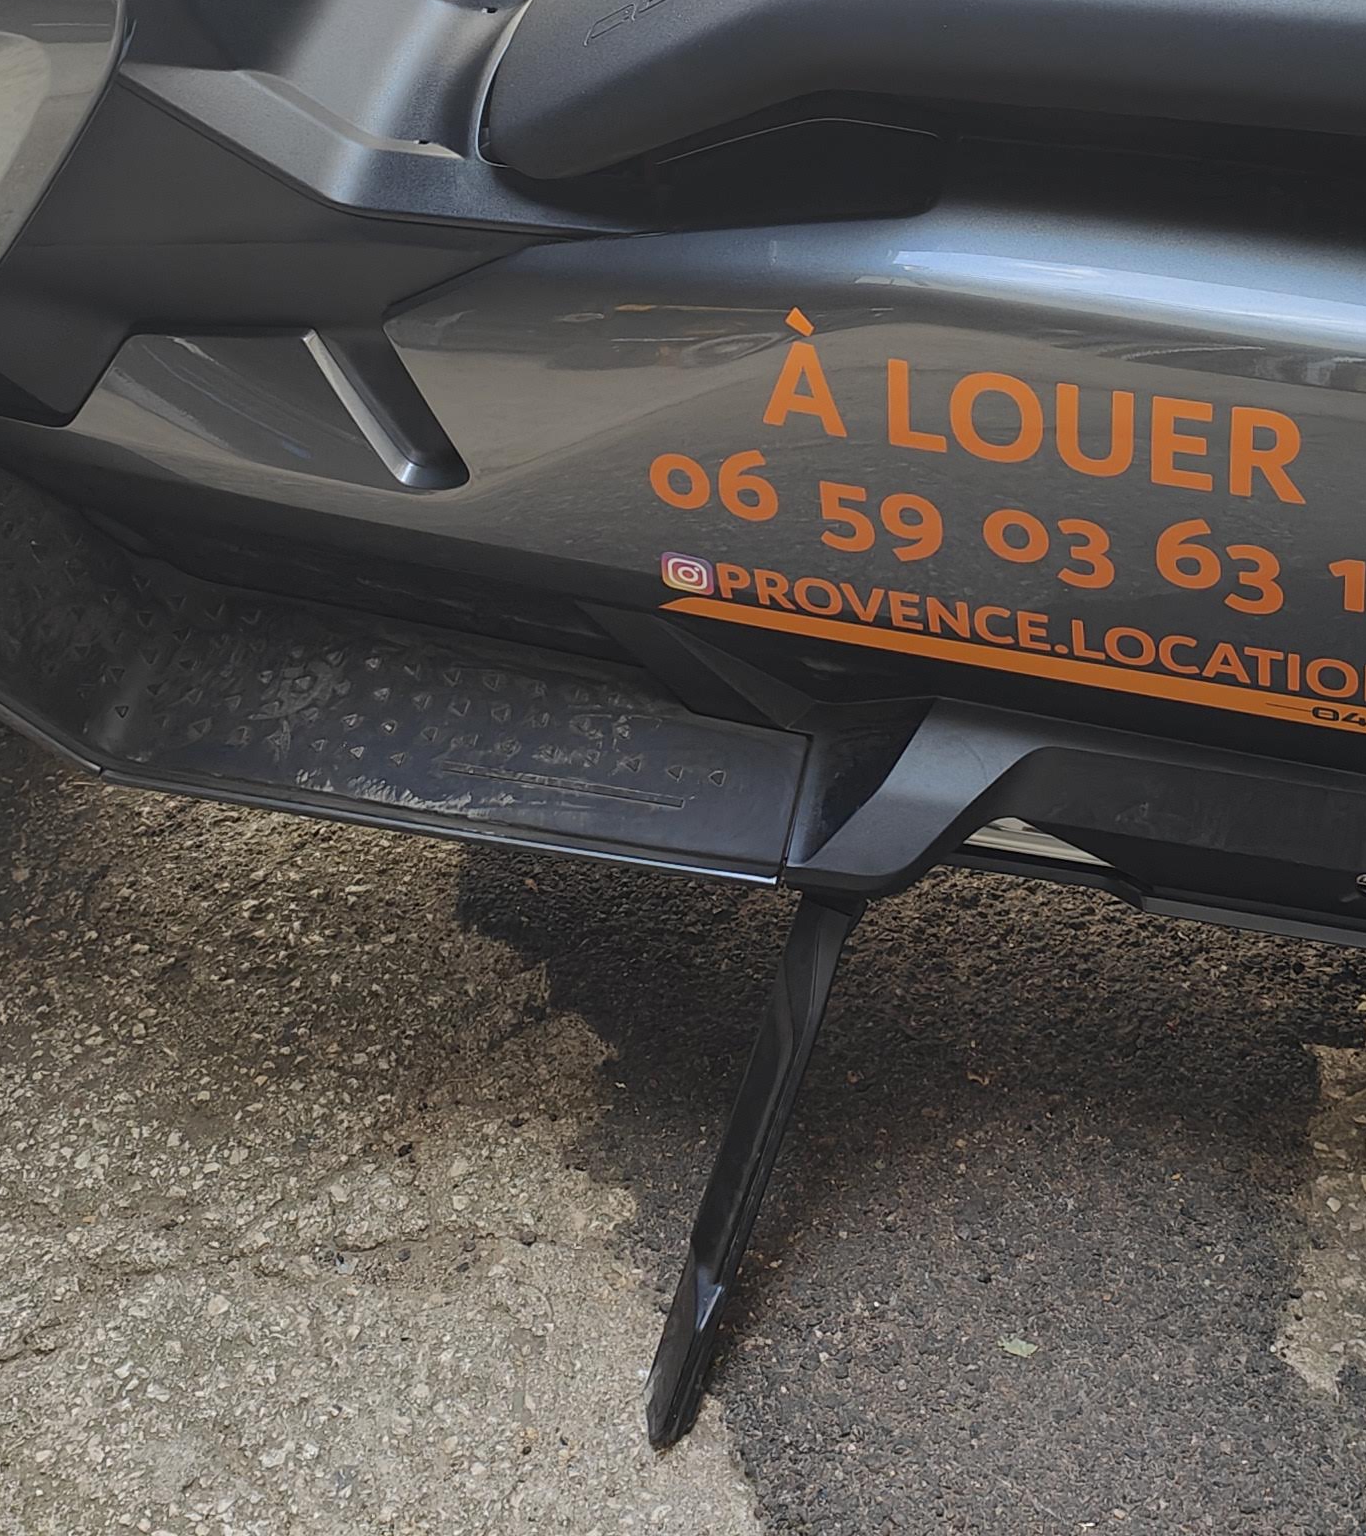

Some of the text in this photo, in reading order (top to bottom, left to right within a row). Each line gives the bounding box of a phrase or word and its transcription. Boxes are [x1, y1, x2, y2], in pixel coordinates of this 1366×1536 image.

[763, 308, 1307, 506] À LOUER
[649, 451, 779, 522] 06
[819, 481, 944, 562] 59
[983, 509, 1116, 589] 03
[1156, 519, 1285, 615] 63
